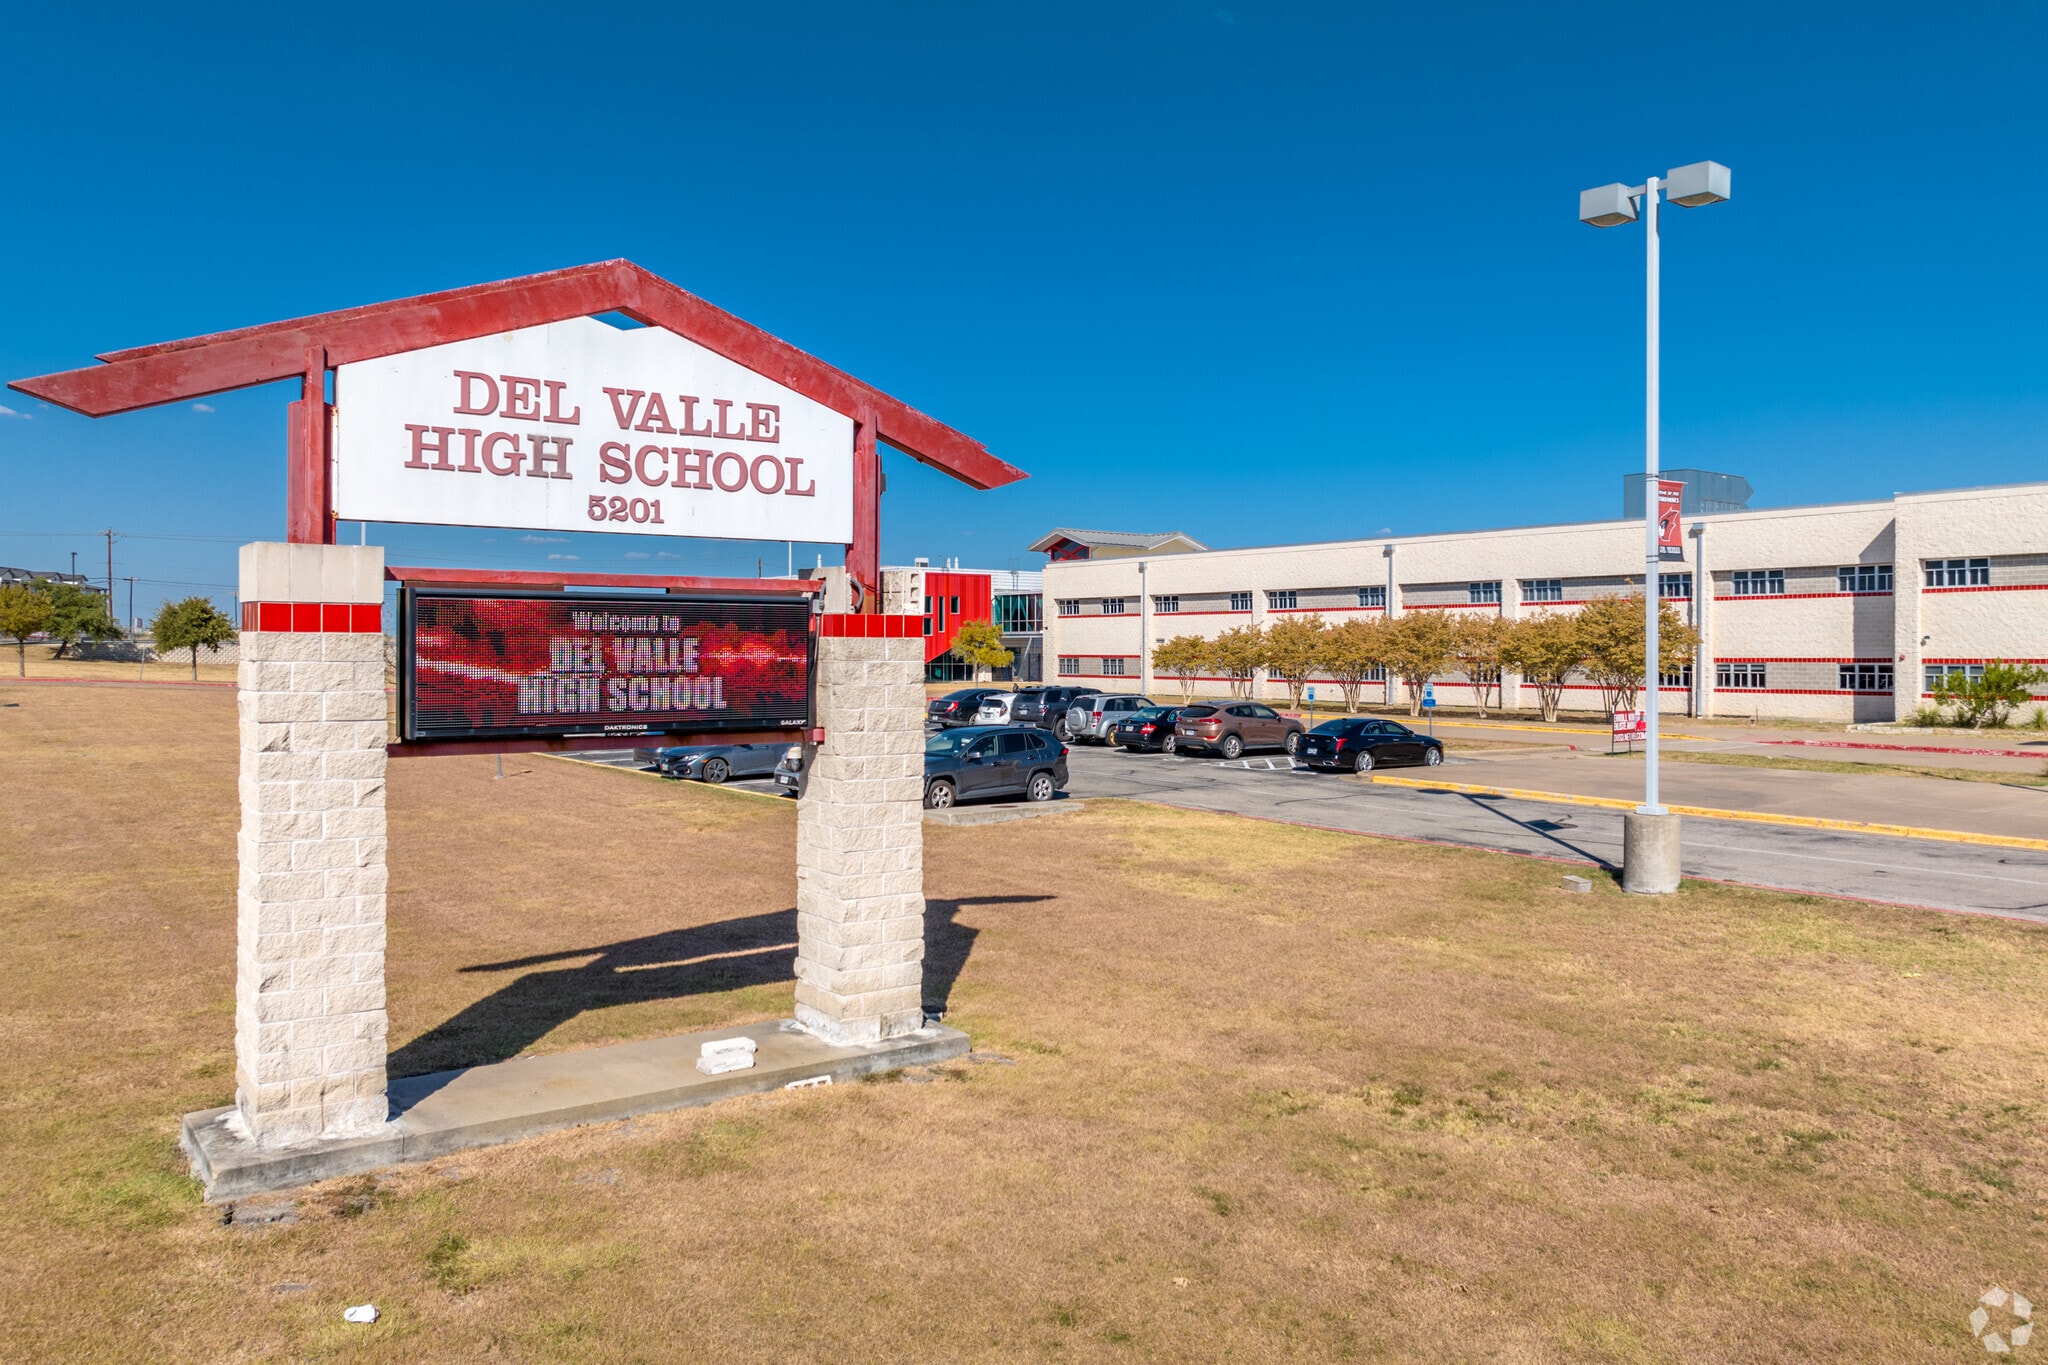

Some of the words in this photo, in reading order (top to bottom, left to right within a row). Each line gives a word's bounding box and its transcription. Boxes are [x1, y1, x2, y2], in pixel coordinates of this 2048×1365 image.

[453, 370, 580, 425] DEL
[602, 386, 780, 443] VALLE
[404, 423, 573, 480] HIGH
[599, 441, 816, 497] SCHOOL
[587, 495, 664, 524] 5201
[572, 611, 659, 633] Welcome
[662, 615, 681, 633] to
[549, 637, 604, 674] DEL
[613, 637, 699, 673] VALLE
[517, 677, 600, 713] HIGH
[607, 676, 727, 711] SCHOOL
